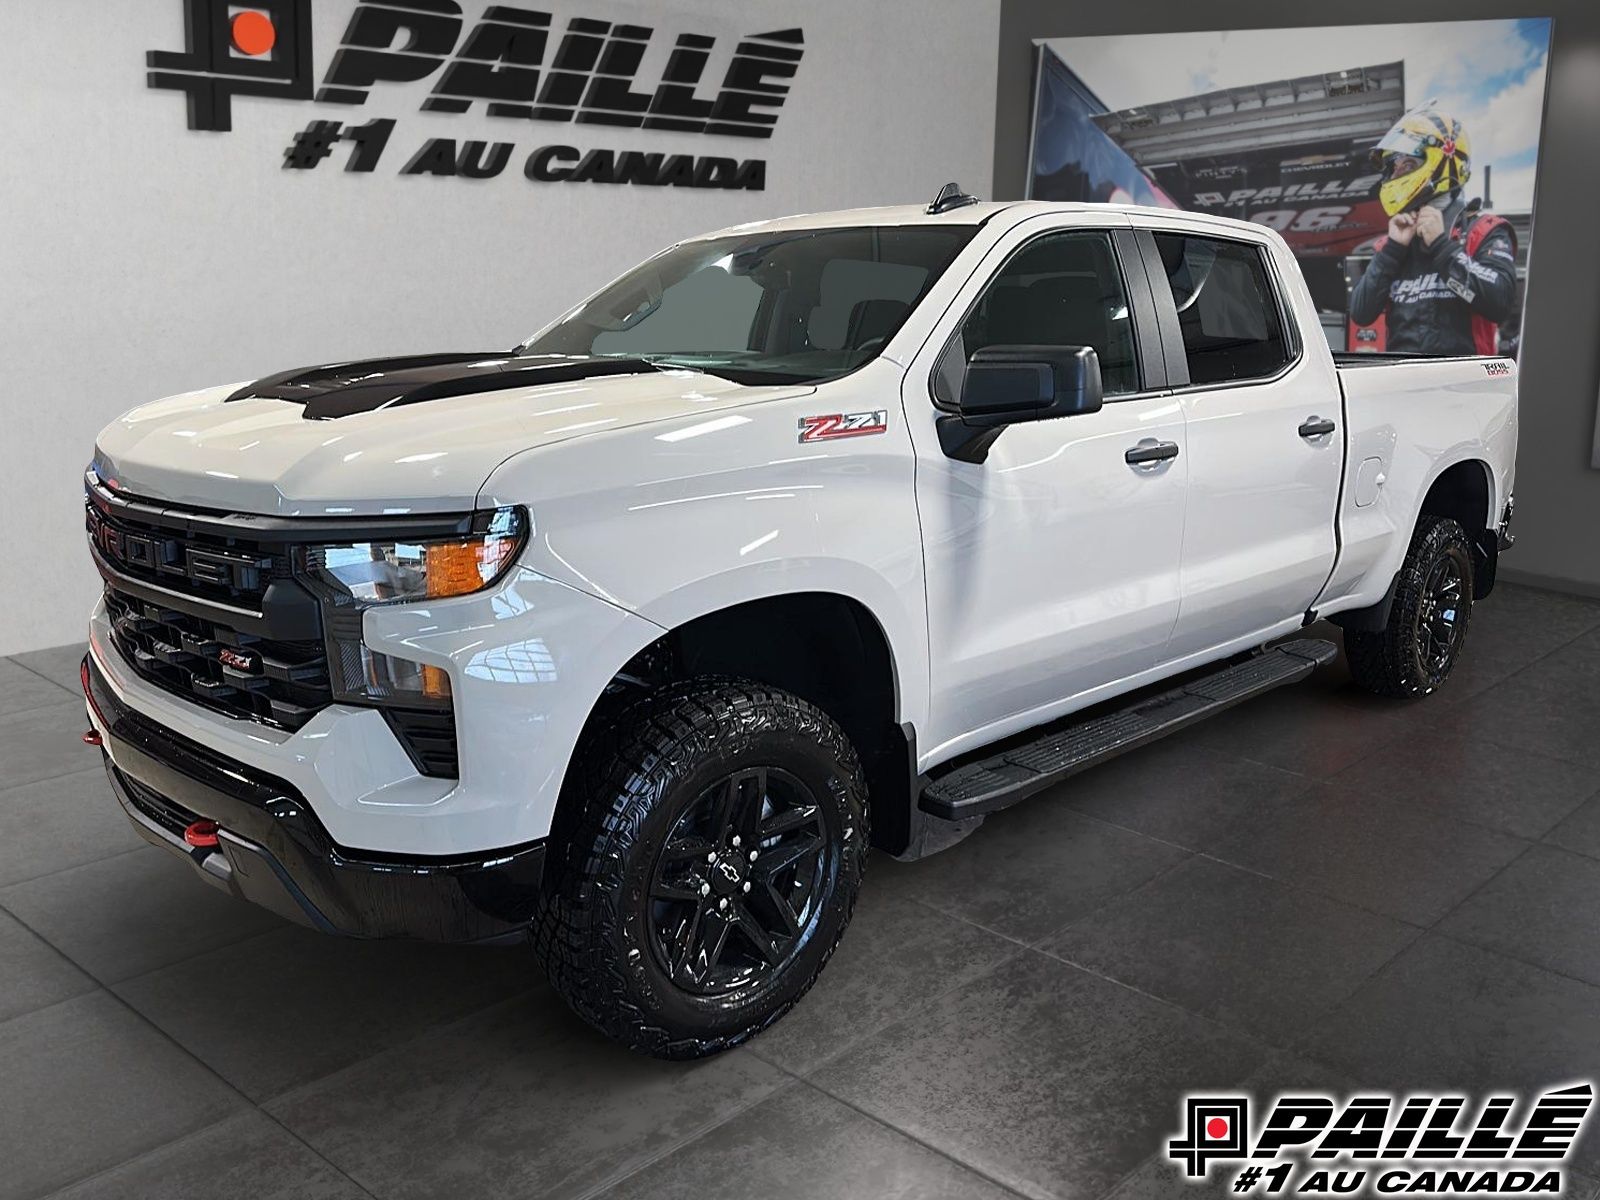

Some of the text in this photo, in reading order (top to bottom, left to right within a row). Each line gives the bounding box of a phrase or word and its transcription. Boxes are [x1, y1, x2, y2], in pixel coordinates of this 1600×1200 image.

[314, 0, 805, 139] PAILLÉ
[281, 118, 767, 191] #1 AU CANADA
[1279, 161, 1351, 174] CHEVROLET
[1282, 190, 1370, 203] CANADA
[1251, 205, 1352, 233] 96
[797, 409, 888, 444] Z71
